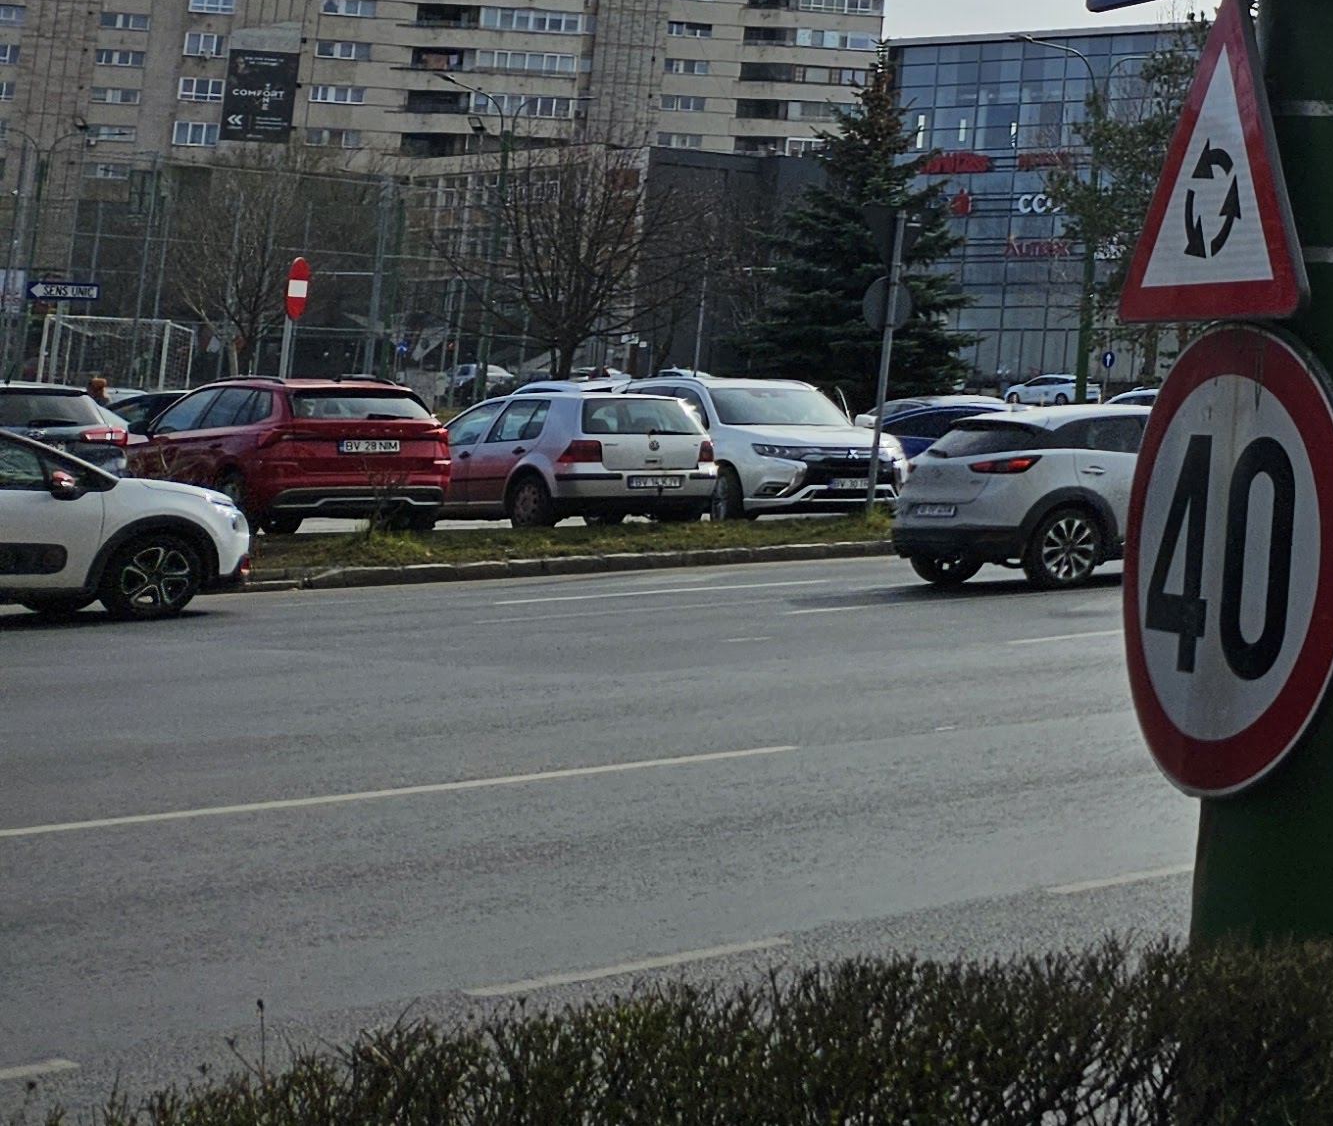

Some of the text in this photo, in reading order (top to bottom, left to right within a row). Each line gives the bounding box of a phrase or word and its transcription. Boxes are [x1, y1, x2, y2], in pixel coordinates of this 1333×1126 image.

[232, 88, 285, 97] COMFORT
[43, 285, 94, 297] SENS UNIC
[345, 441, 361, 451] BV
[379, 441, 398, 450] NIM
[1145, 434, 1296, 680] 40
